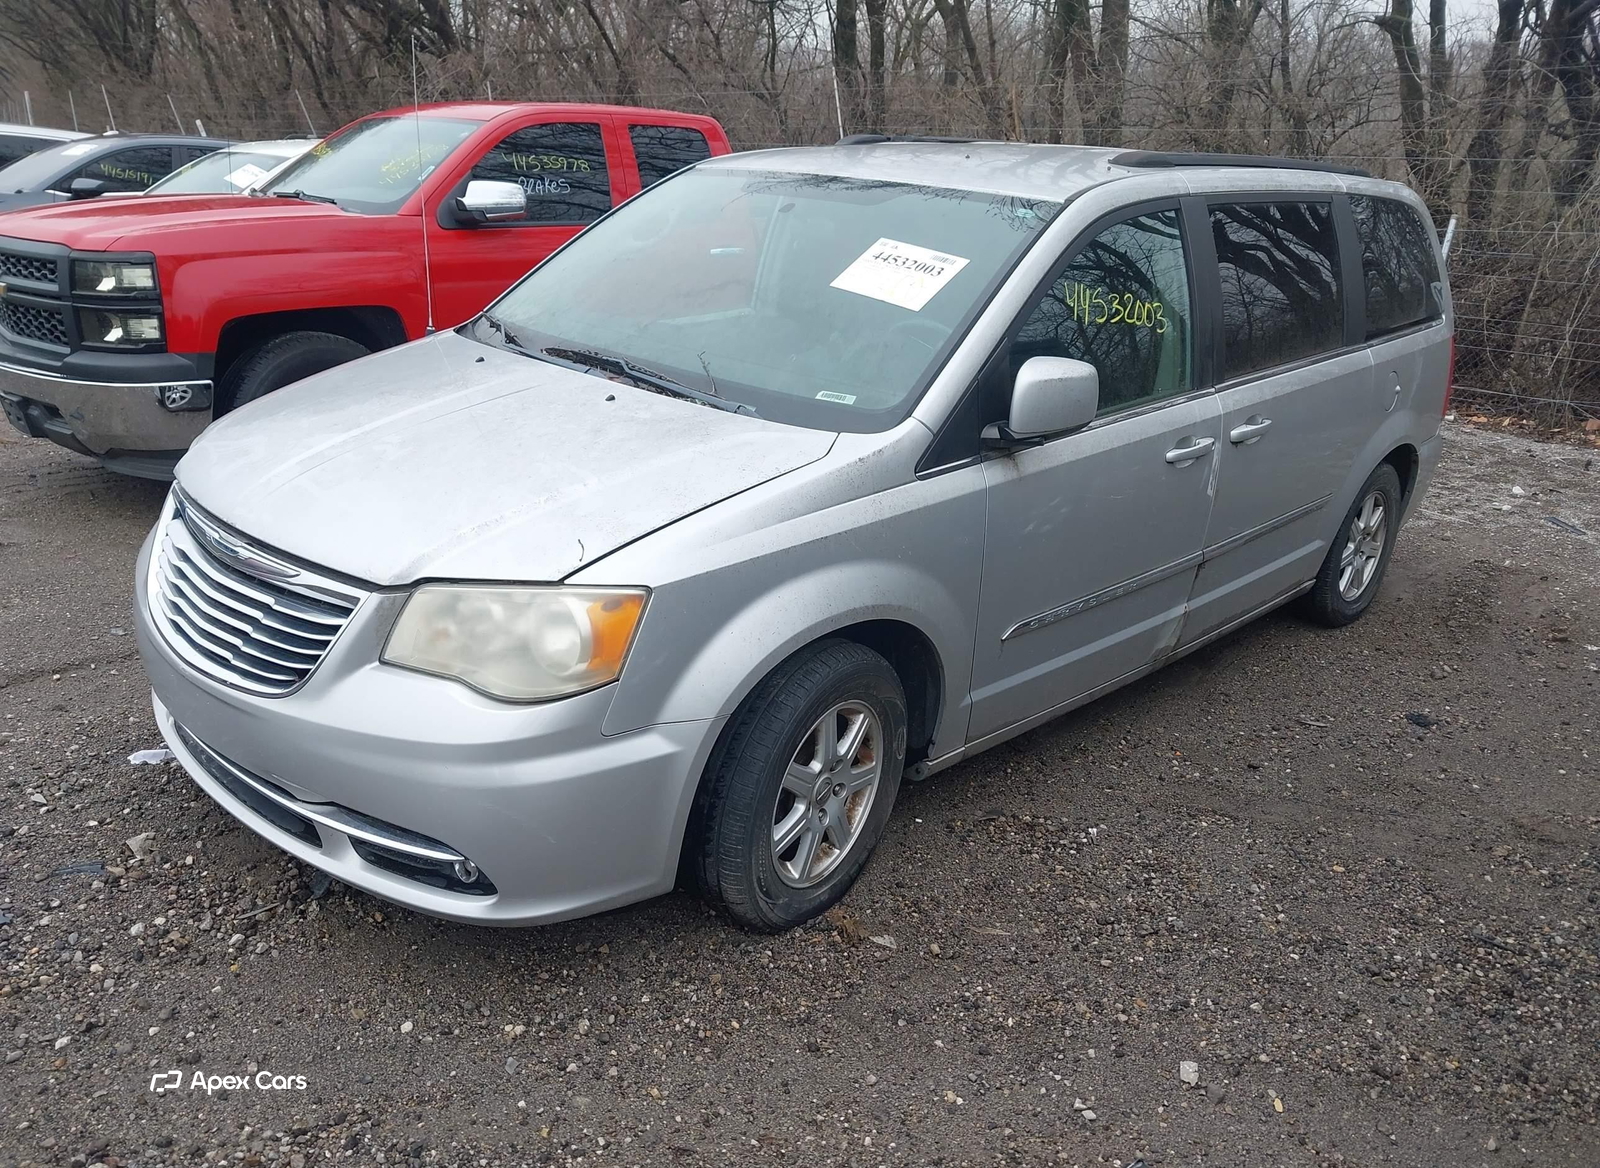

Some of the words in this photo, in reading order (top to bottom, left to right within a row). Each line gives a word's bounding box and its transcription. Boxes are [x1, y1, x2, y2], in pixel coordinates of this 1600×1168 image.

[501, 152, 591, 172] 44535978
[872, 251, 945, 277] 44532003
[1064, 281, 1168, 333] 44532003
